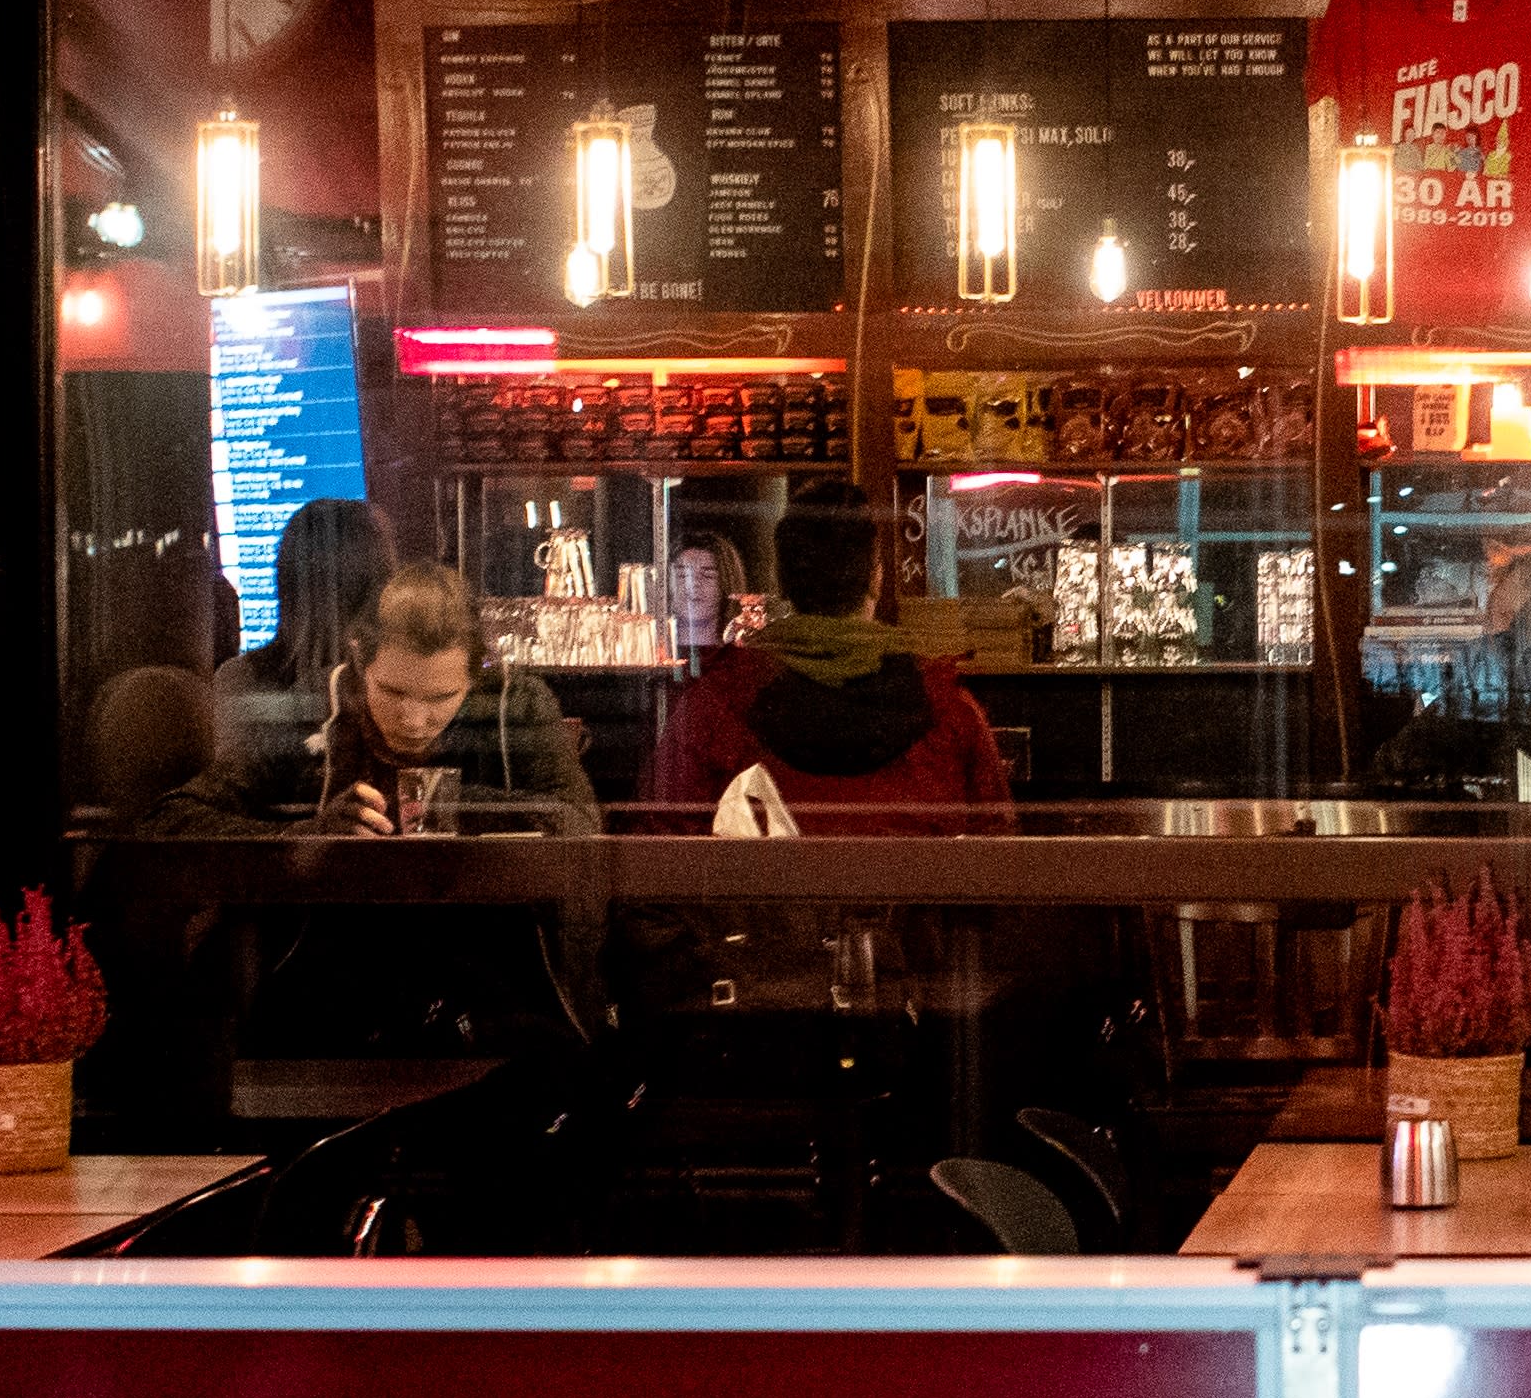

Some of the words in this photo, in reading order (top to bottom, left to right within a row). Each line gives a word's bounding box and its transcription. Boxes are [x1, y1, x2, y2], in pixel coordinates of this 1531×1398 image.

[1176, 33, 1204, 46] PART
[1204, 33, 1219, 46] OF
[1220, 33, 1240, 46] OUR
[1242, 33, 1283, 46] SERVICE
[1169, 49, 1194, 61] WILL
[1199, 49, 1219, 61] LET
[1223, 49, 1244, 61] YOU
[1248, 49, 1278, 61] KNOW
[1147, 64, 1178, 77] WHEN
[1220, 64, 1241, 76] HAD
[1245, 64, 1285, 76] ENOUGH
[939, 93, 974, 112] SOFT
[1391, 61, 1520, 144] FIASCO
[1394, 176, 1445, 207] 30
[1454, 169, 1514, 208] ÅR
[1135, 288, 1228, 309] VELKOMMEN
